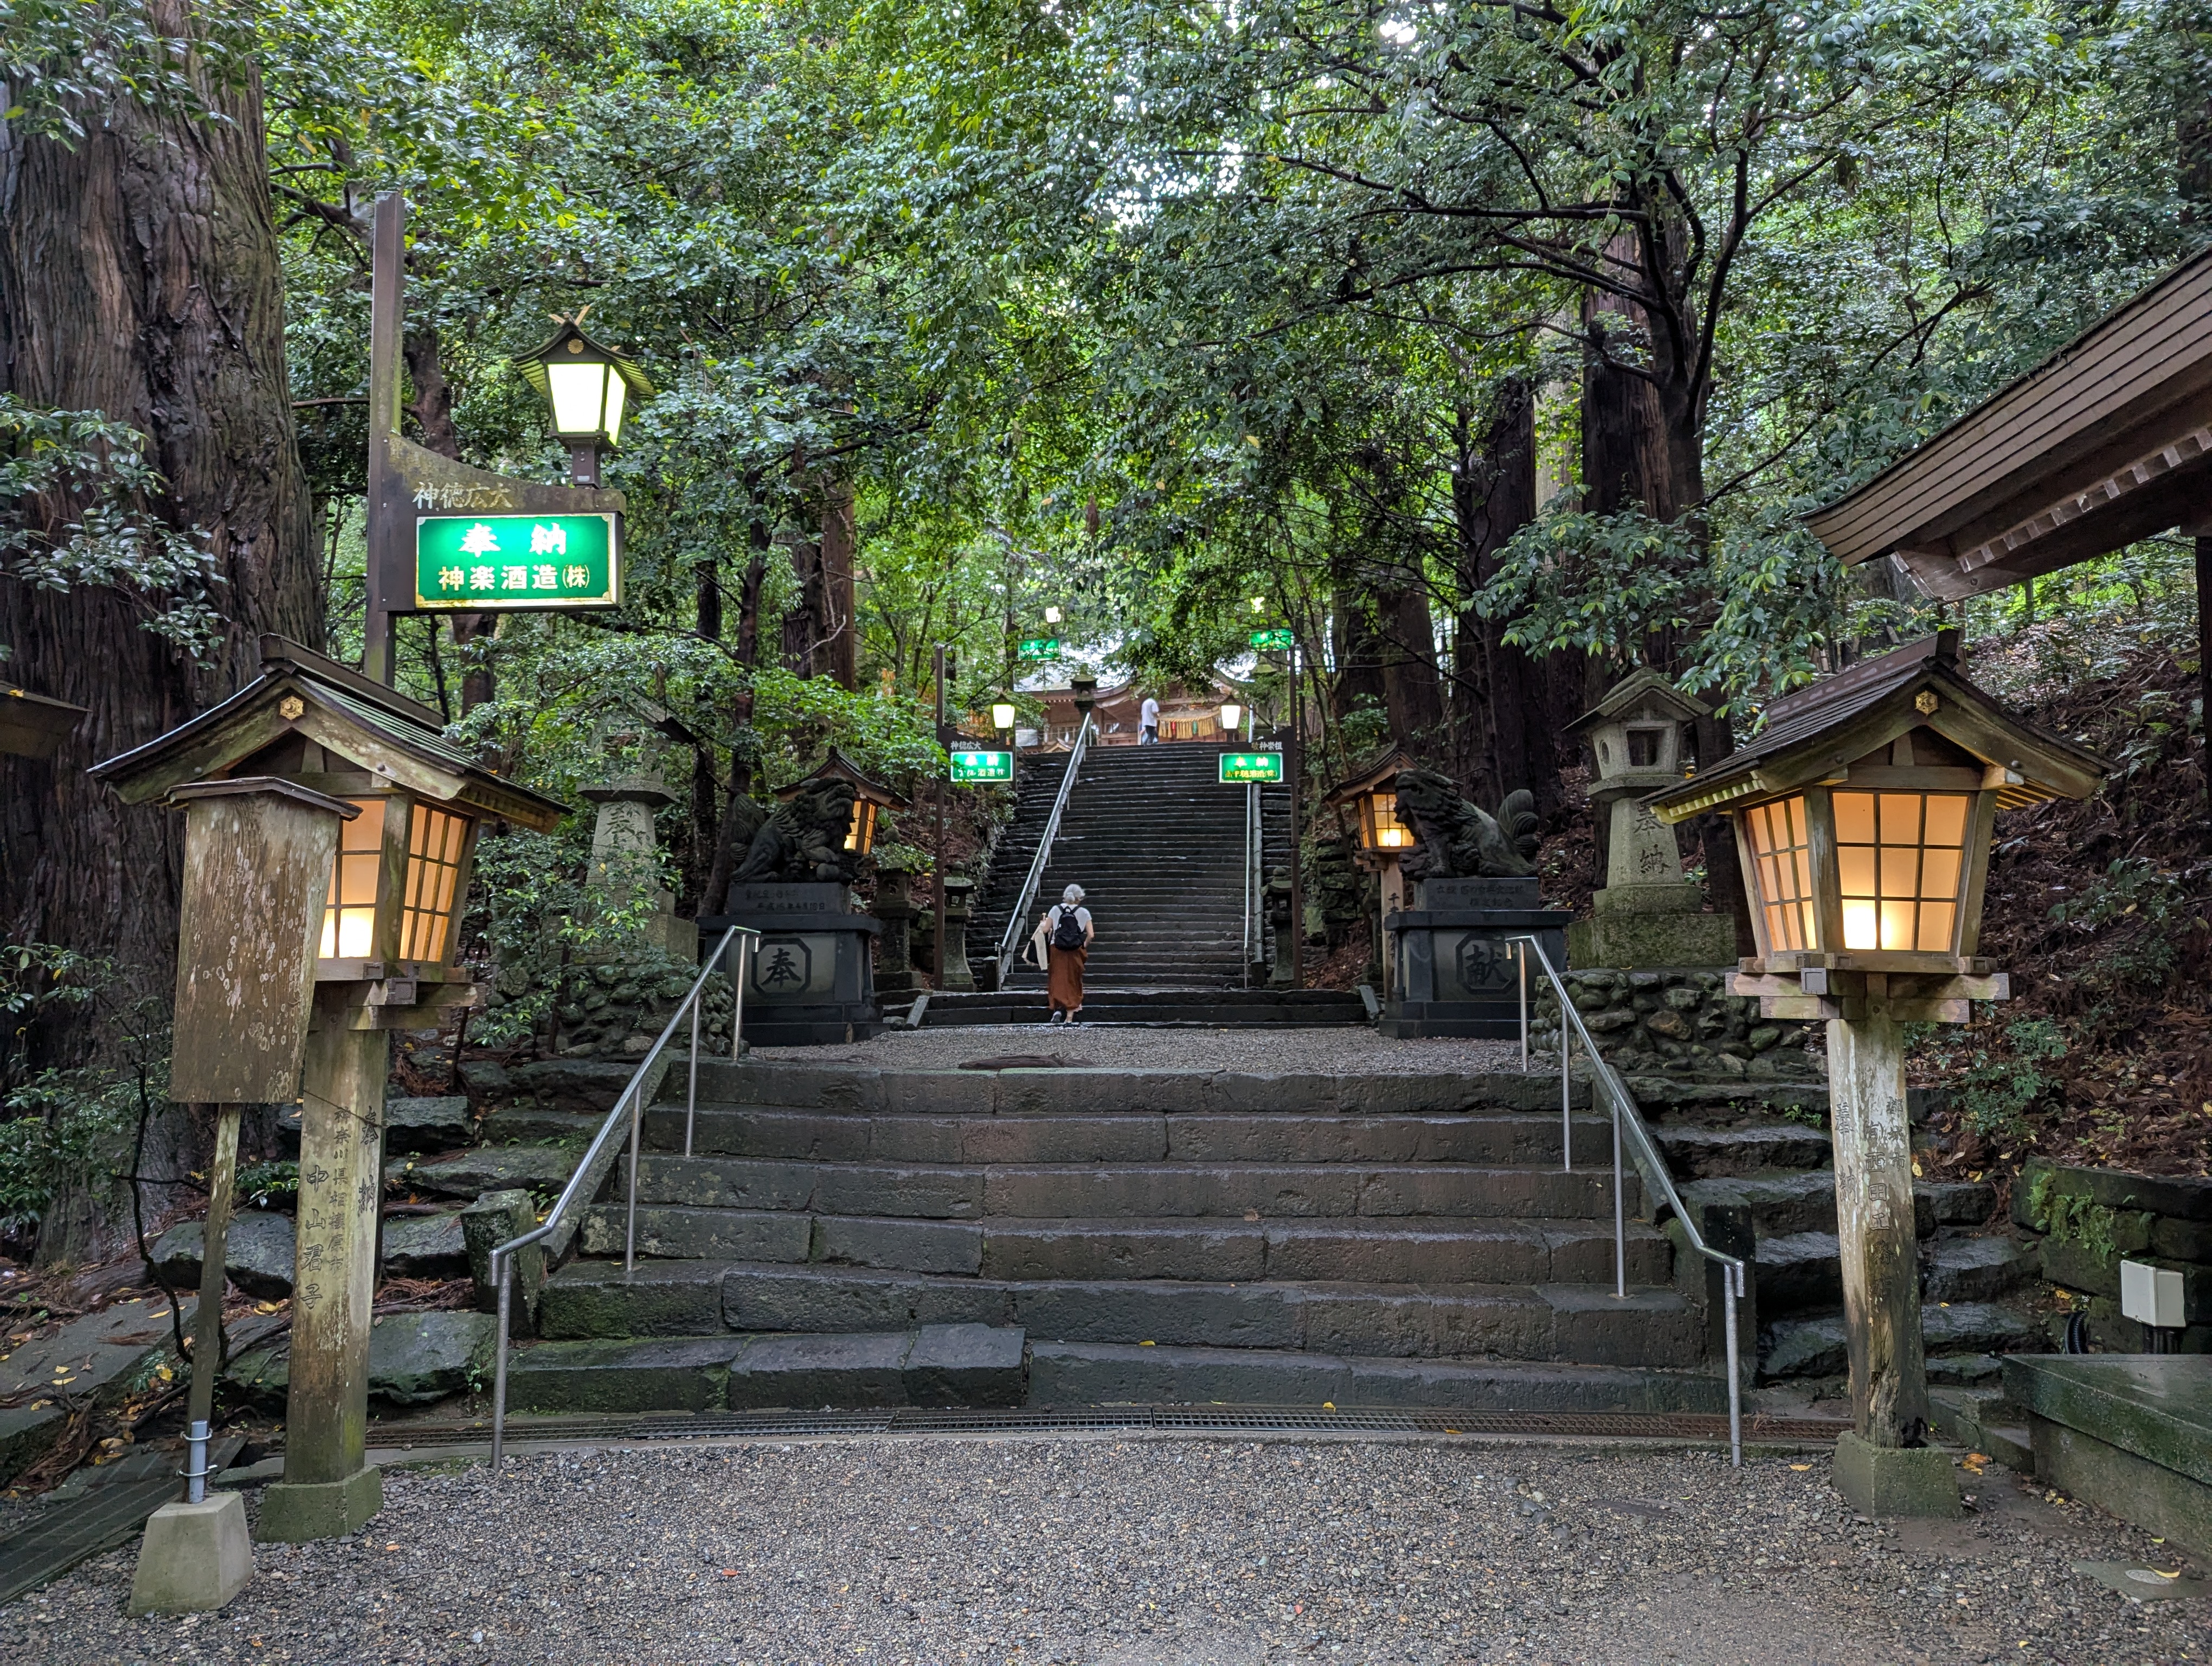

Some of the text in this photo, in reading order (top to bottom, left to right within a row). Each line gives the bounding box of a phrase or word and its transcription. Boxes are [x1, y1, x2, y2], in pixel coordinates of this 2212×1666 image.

[412, 482, 514, 509] 神徳広大
[761, 947, 802, 989] 奉
